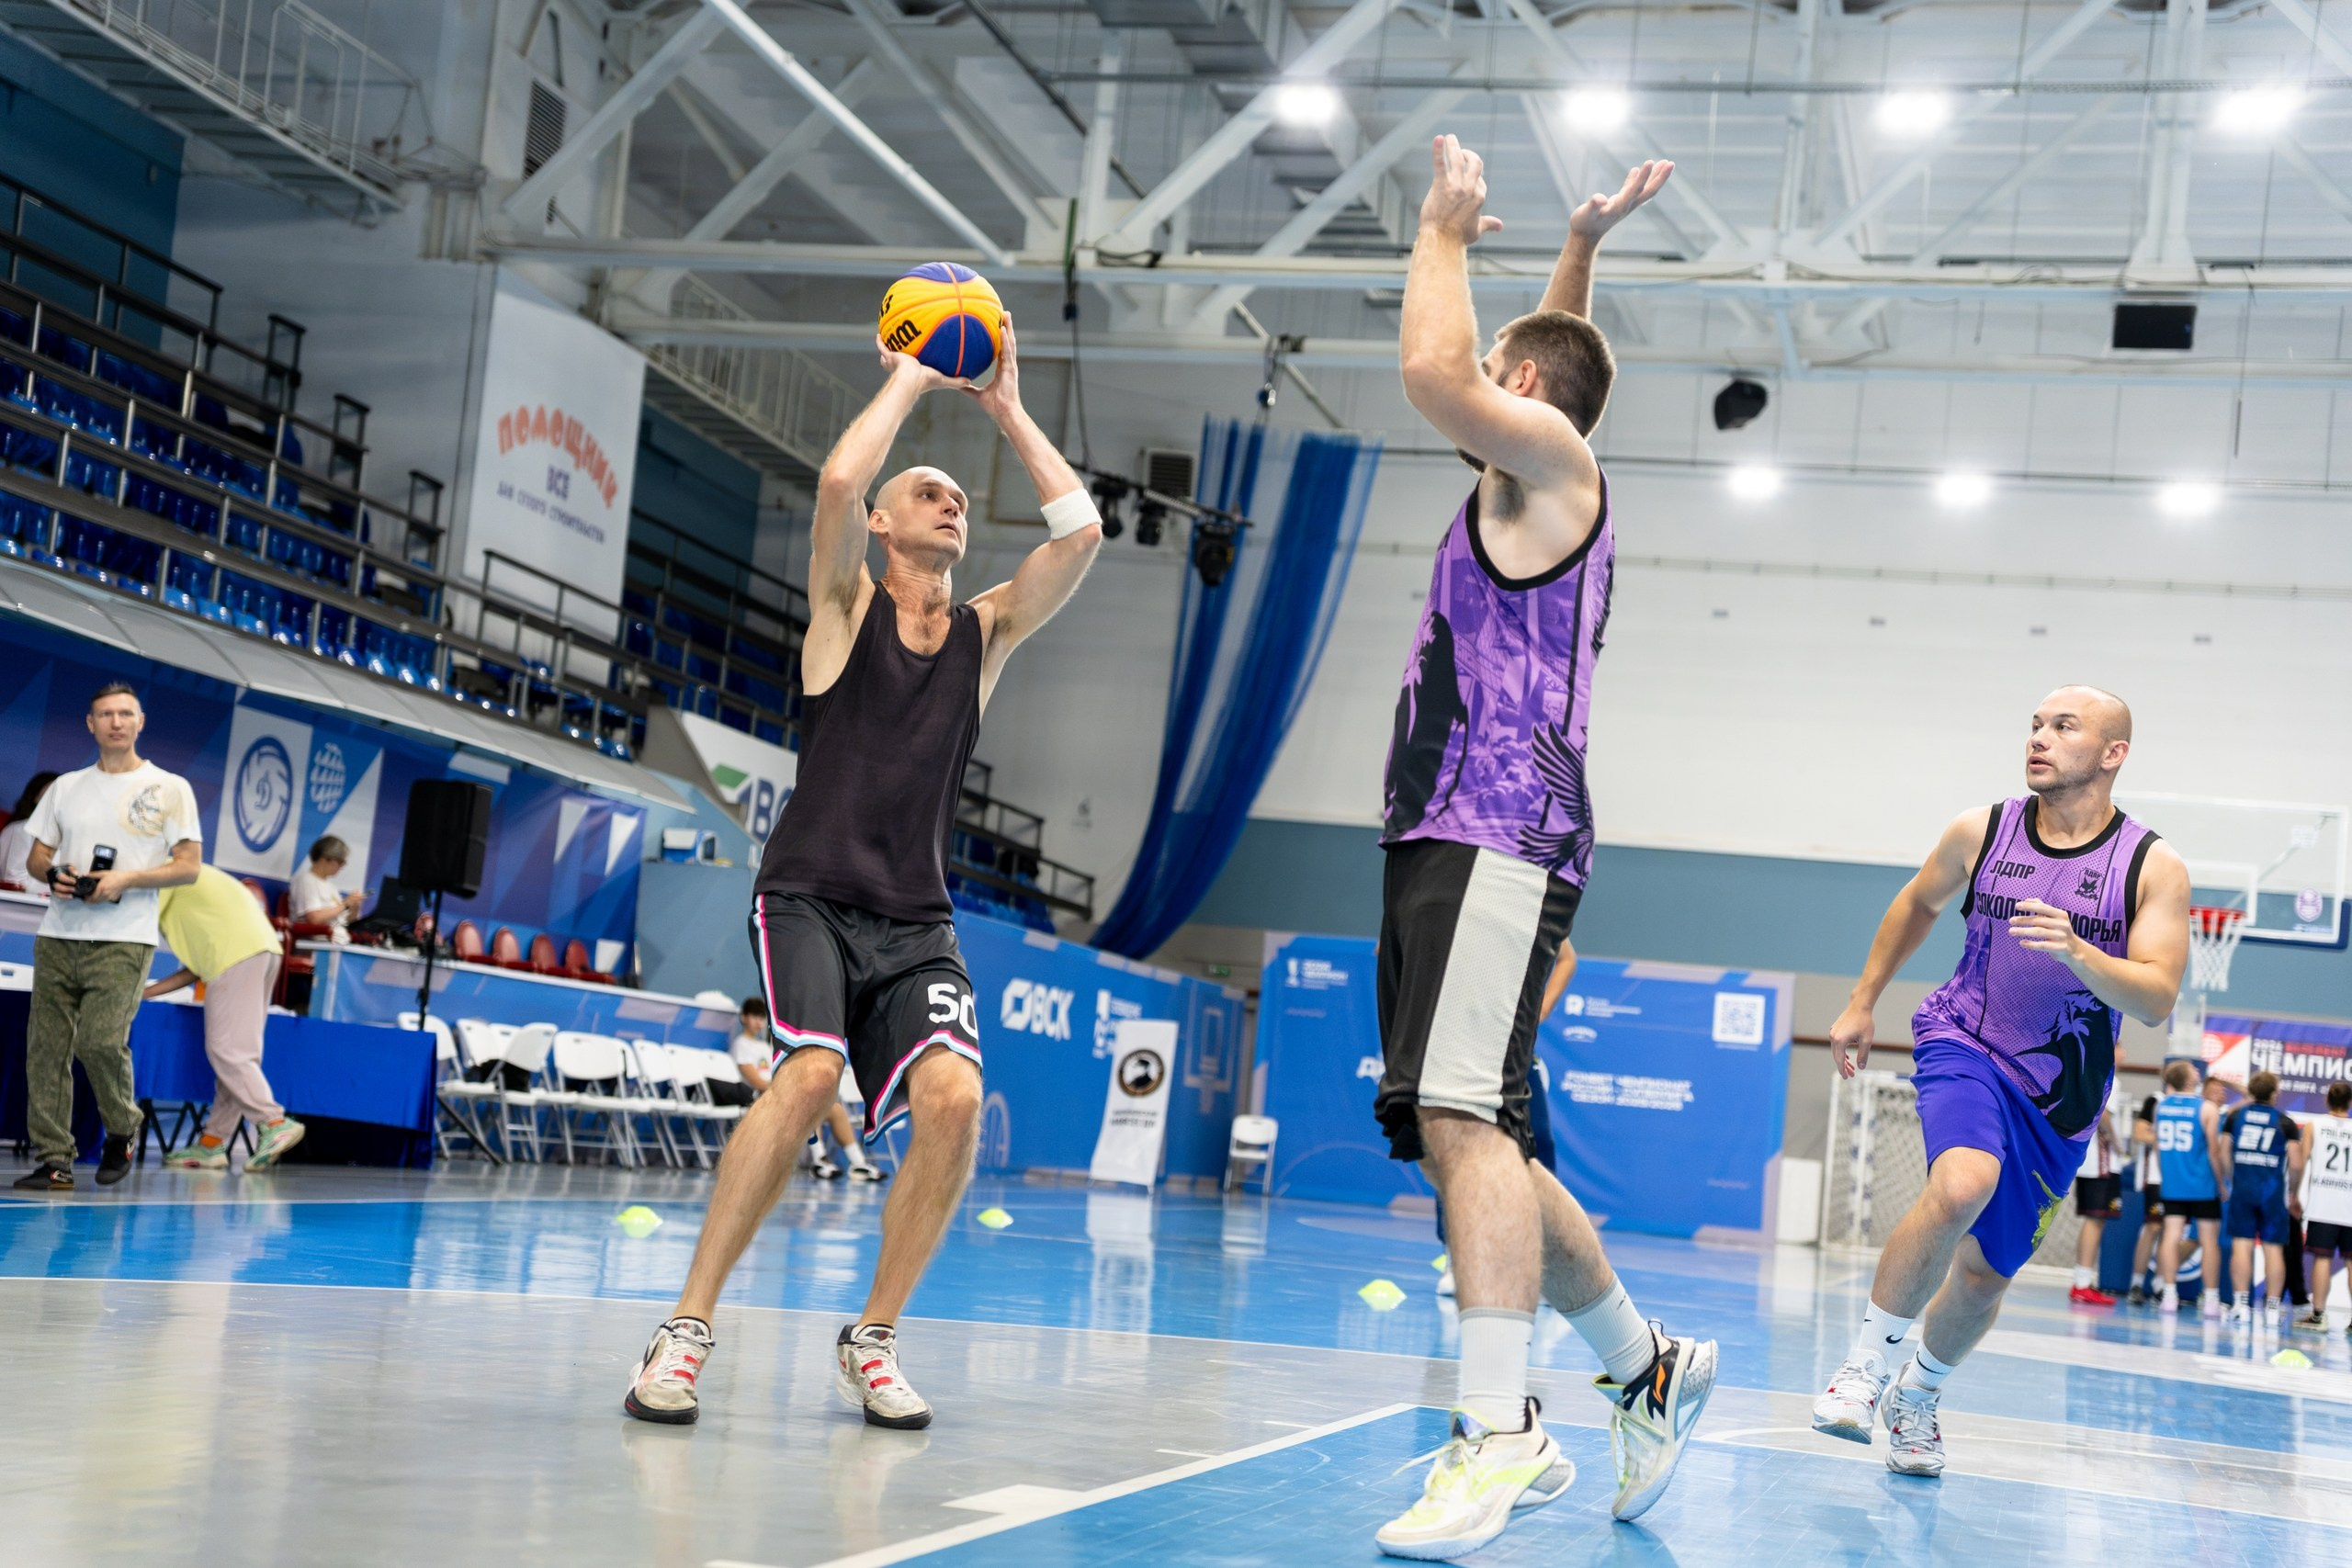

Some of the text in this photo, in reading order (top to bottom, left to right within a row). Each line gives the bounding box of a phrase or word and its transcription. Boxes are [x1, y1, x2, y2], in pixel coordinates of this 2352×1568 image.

[1990, 861, 2036, 879] ЛДПР
[2085, 869, 2101, 879] ЛДПР
[2065, 910, 2123, 942] МОРЬЯ
[927, 983, 978, 1041] 50
[2158, 1119, 2194, 1153] 95
[2237, 1123, 2277, 1153] 21
[2326, 1142, 2350, 1173] 21
